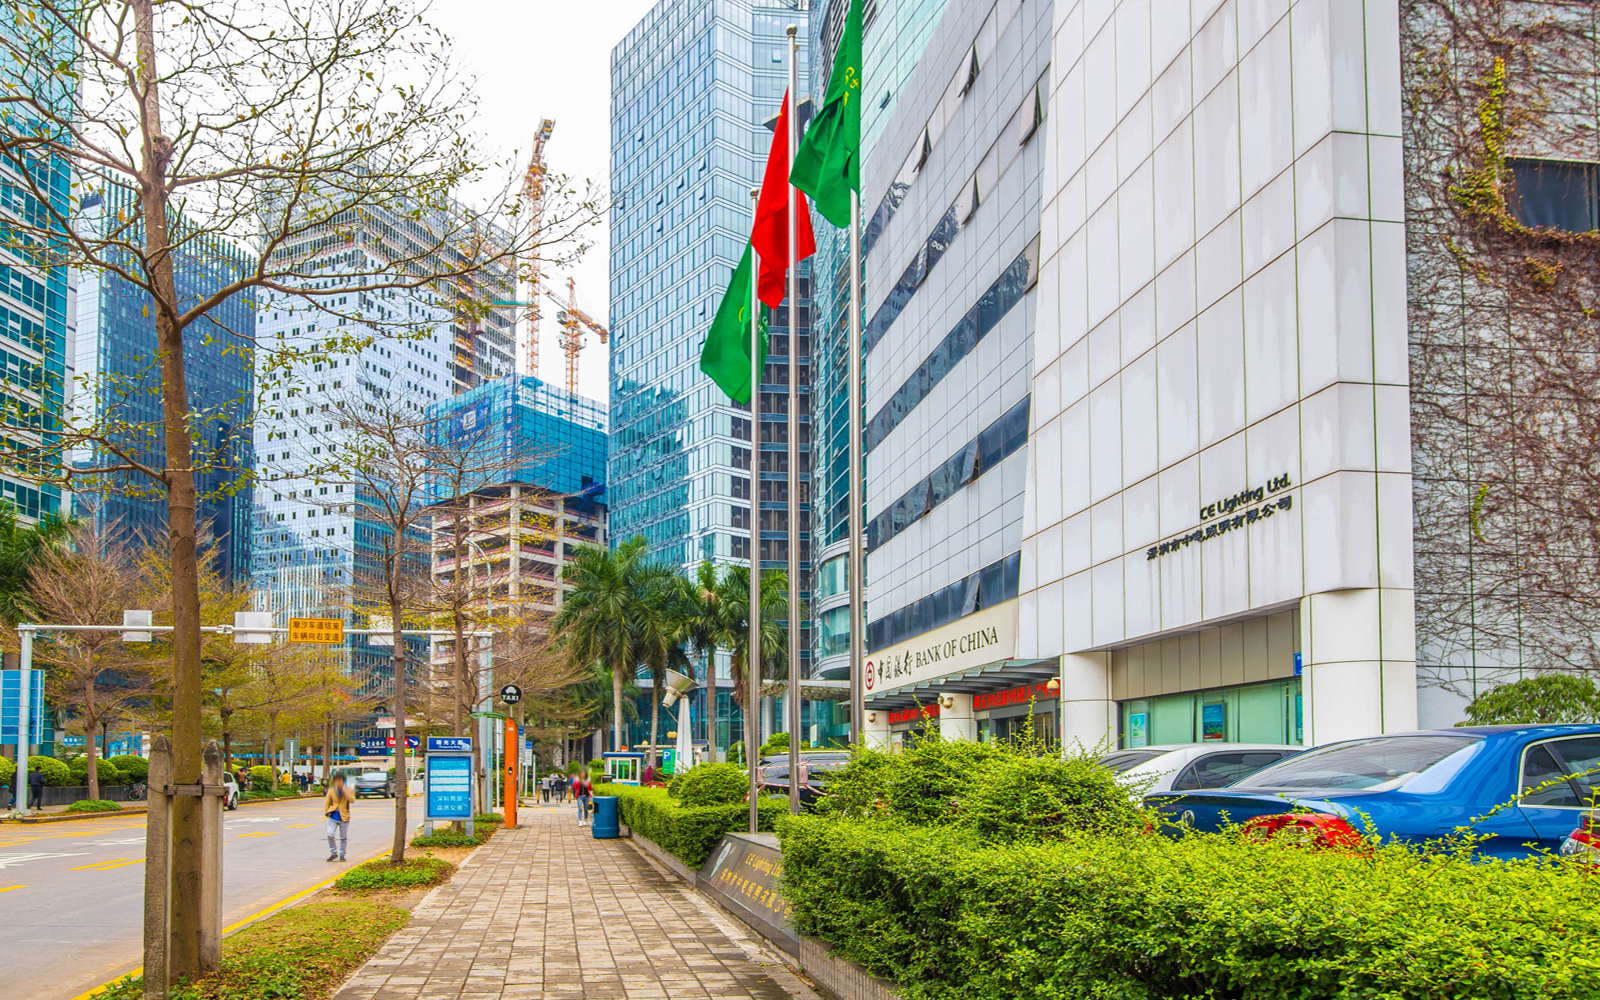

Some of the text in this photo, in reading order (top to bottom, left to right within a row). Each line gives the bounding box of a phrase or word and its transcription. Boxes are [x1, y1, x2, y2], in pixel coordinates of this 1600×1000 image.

[1200, 472, 1292, 520] CE Lighting Ltd.
[1146, 495, 1293, 561] 深圳市中电照明有限公司
[292, 620, 340, 630] 潮汐车道结束
[292, 631, 340, 642] 车辆向右变道
[915, 626, 999, 668] BANK OF CHINA
[877, 649, 914, 684] 中国银行
[663, 751, 670, 760] P
[745, 853, 756, 866] CE
[752, 854, 774, 876] Lighting
